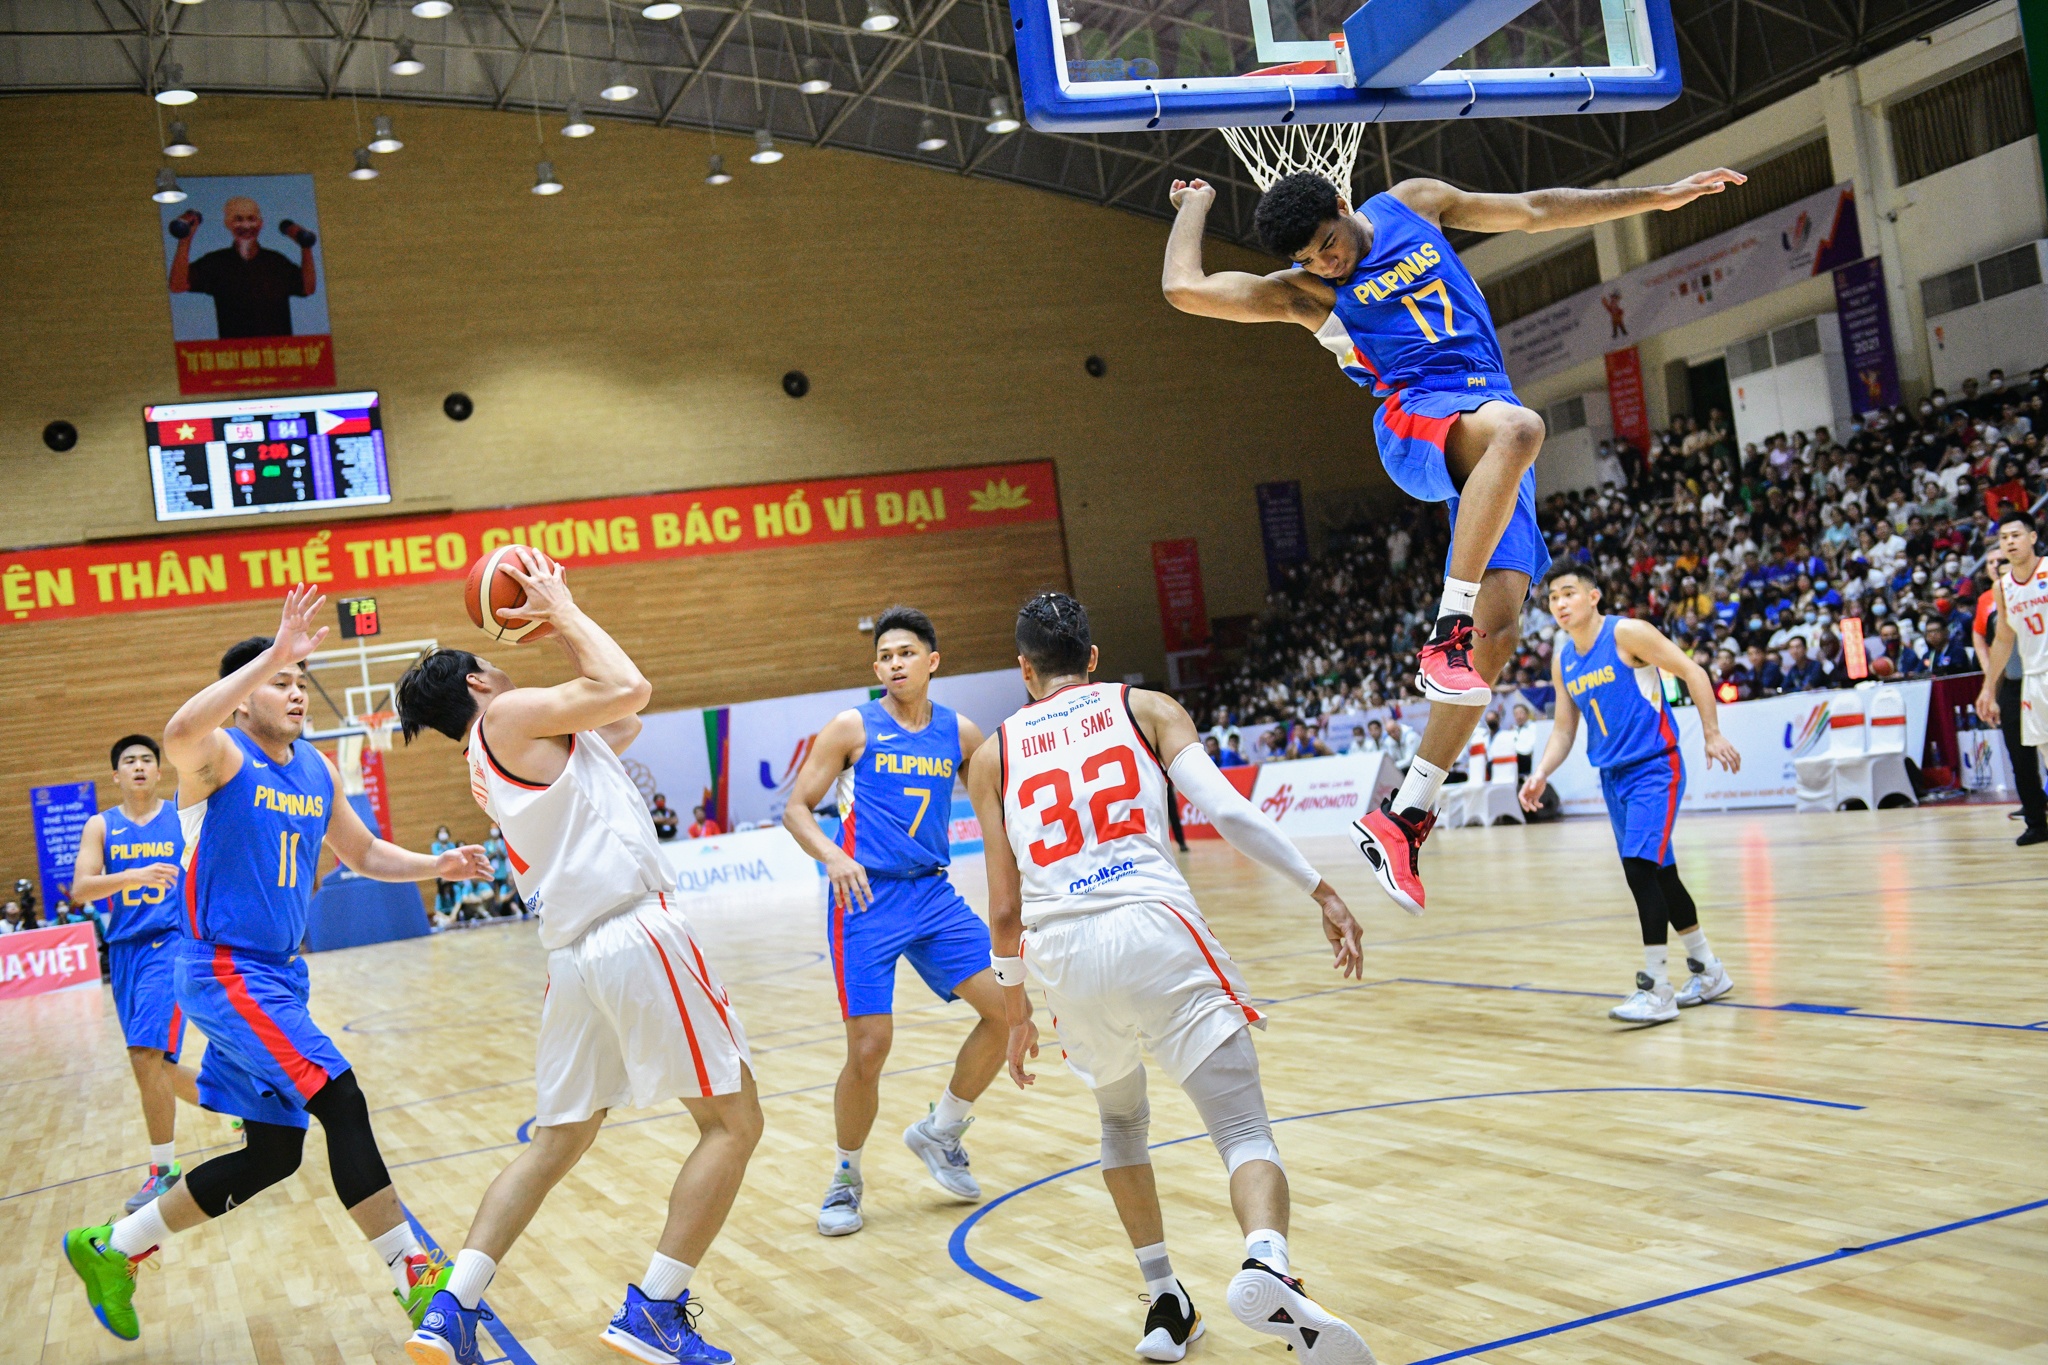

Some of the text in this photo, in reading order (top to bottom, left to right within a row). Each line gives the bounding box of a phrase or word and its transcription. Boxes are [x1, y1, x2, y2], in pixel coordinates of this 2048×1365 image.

[1353, 242, 1441, 305] PILIPINAS
[1401, 278, 1457, 343] 17
[1467, 376, 1486, 388] PHI
[278, 420, 298, 440] 84
[89, 550, 228, 602] THÂN
[240, 530, 333, 589] THỂ
[346, 533, 467, 579] THEO
[652, 502, 742, 549] BÁC
[823, 488, 865, 531] VĨ
[876, 487, 946, 531] ĐẠI
[355, 612, 378, 636] 18
[1021, 708, 1113, 758] ĐINH T. SANG
[1590, 698, 1608, 737] 1
[875, 753, 953, 778] PILIPINAS
[254, 785, 323, 818] PILIPINAS
[904, 787, 931, 837] 7
[1017, 745, 1147, 868] 32
[1295, 793, 1358, 811] AJINOMOTO
[111, 841, 174, 860] PILIPINAS
[278, 831, 300, 888] 11
[1069, 860, 1134, 893] molten
[26, 942, 89, 977] VIỆT
